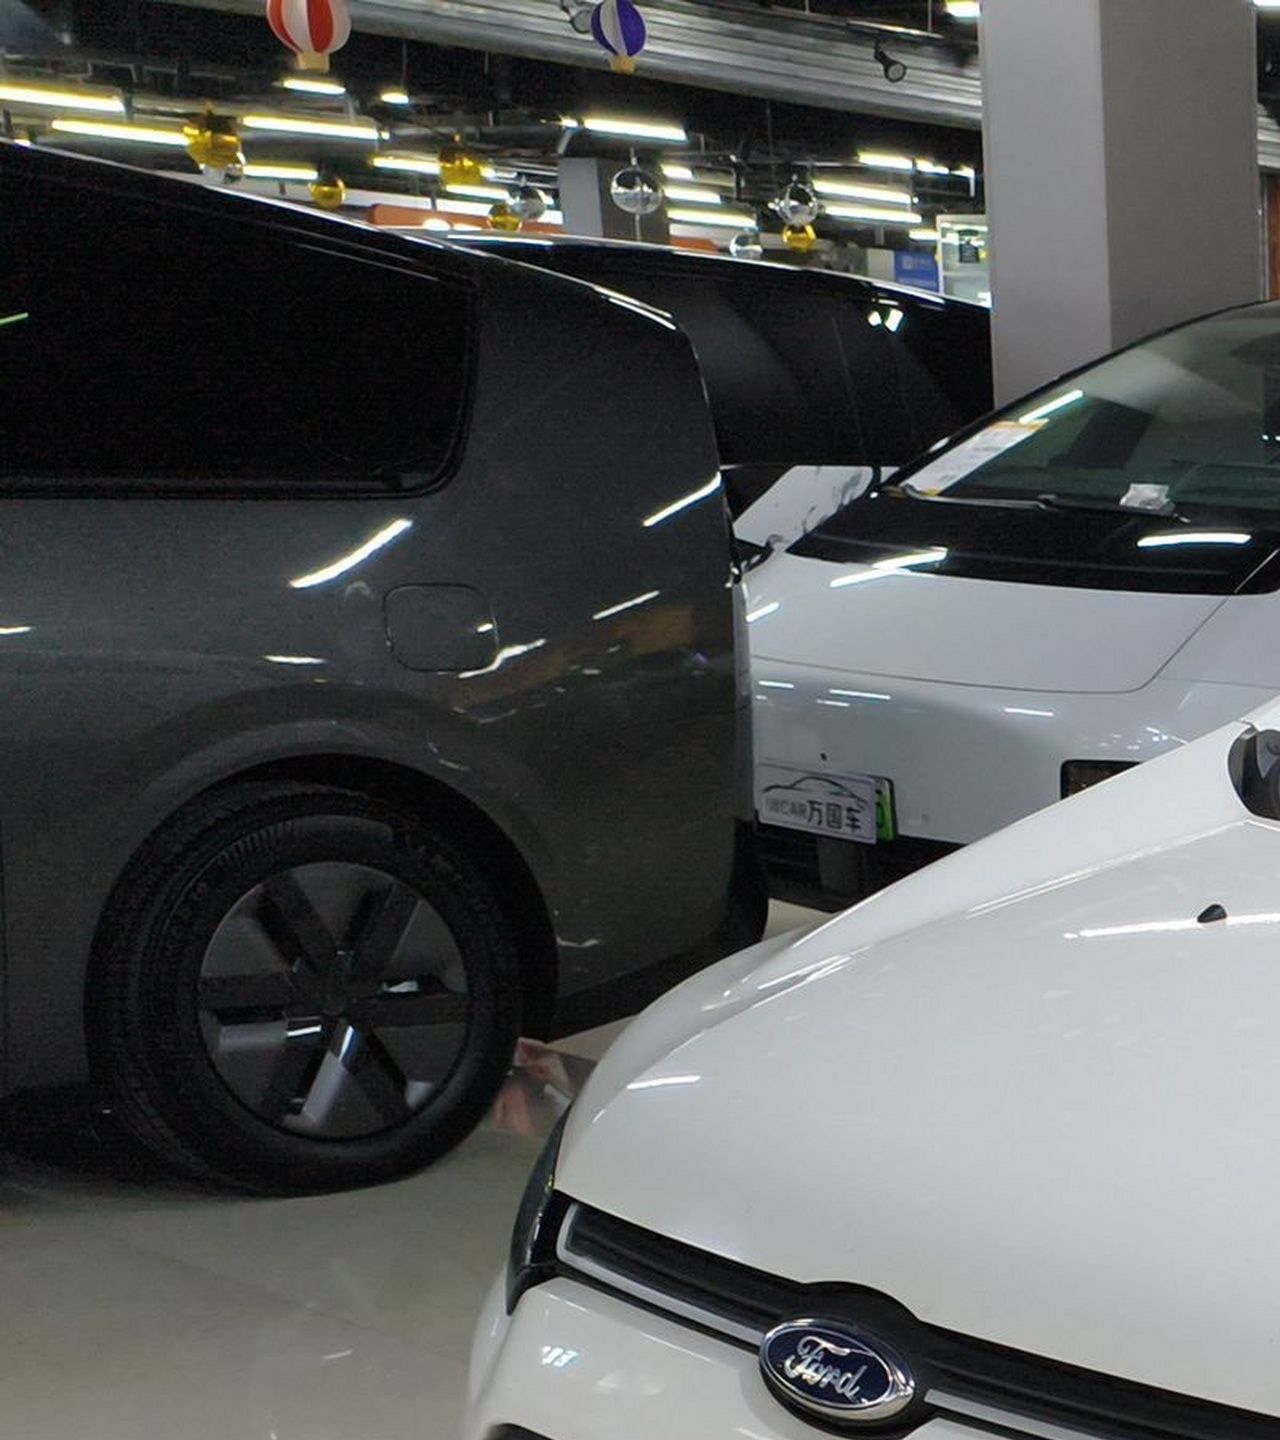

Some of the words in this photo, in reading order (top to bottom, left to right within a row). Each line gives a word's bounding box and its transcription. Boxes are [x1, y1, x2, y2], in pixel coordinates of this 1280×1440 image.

[808, 800, 862, 832] 万国车
[784, 1336, 868, 1404] Ford
